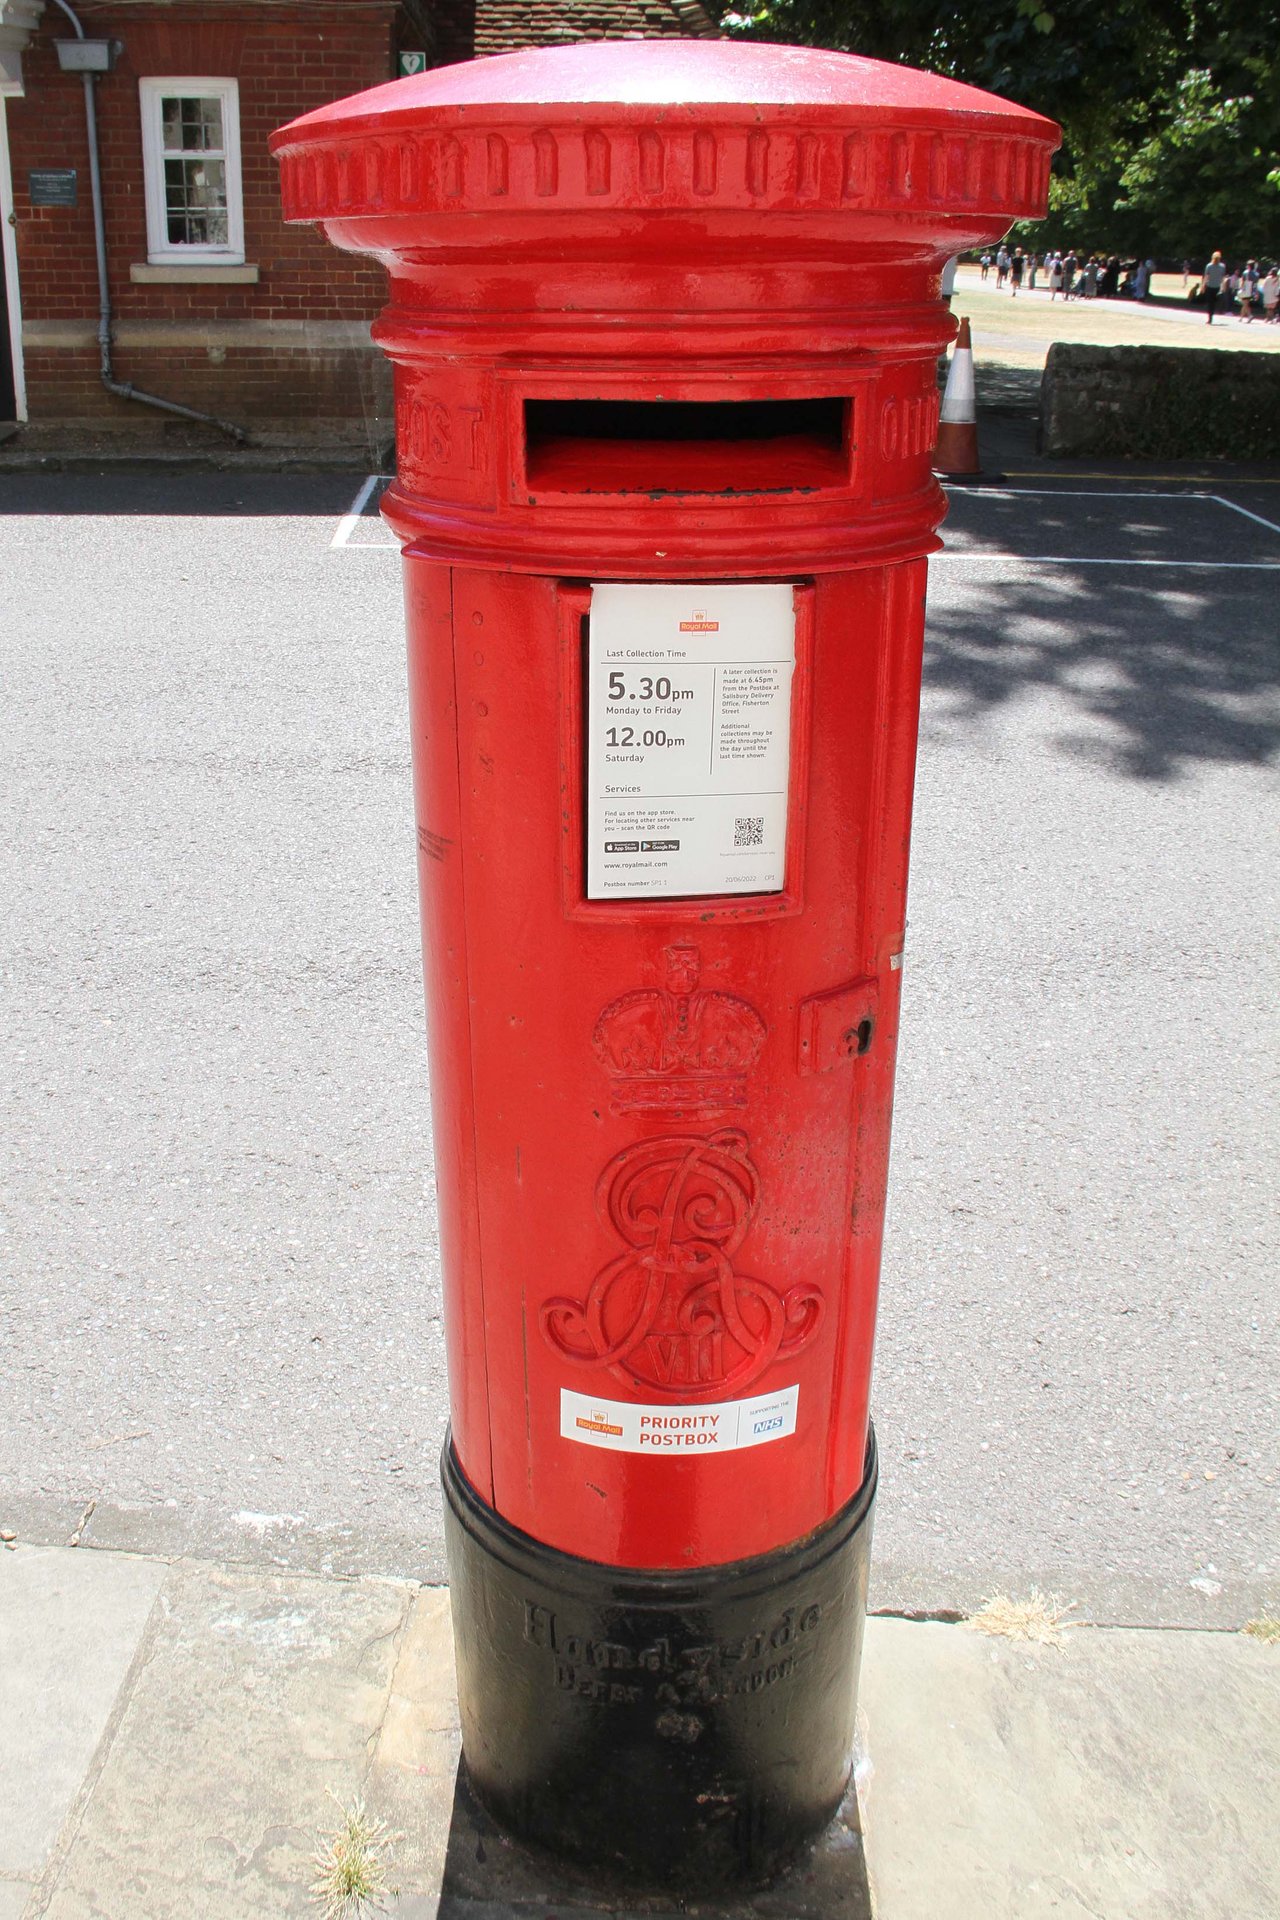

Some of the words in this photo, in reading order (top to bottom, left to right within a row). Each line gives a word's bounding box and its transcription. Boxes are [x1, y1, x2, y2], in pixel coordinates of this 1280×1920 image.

[681, 622, 701, 631] Royal
[702, 622, 718, 630] Mail
[626, 650, 664, 658] Collection
[667, 650, 686, 658] Time
[608, 672, 694, 702] 5.30pm
[606, 706, 640, 716] Monday
[643, 706, 652, 714] to
[654, 706, 682, 716] Friday
[606, 727, 685, 748] 12.00pm
[606, 754, 645, 764] Saturday
[605, 785, 641, 793] Services
[604, 861, 668, 870] www.royalmail.com
[578, 1419, 602, 1432] Royal
[602, 1423, 622, 1434] Mail
[640, 1415, 720, 1429] PRIORITY
[754, 1417, 782, 1433] NHS
[640, 1432, 718, 1446] POSTBOX
